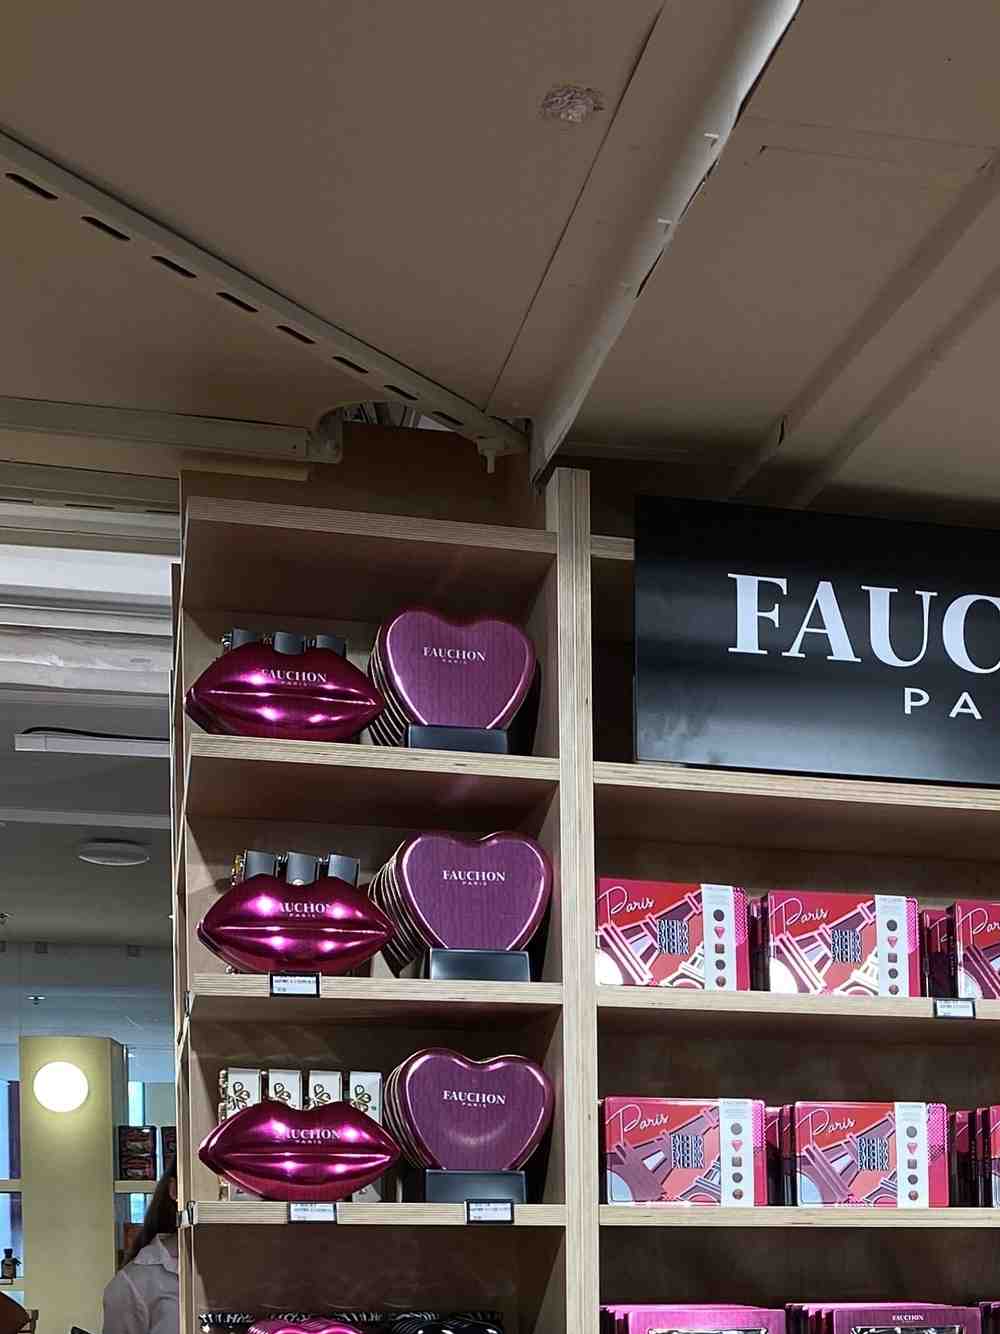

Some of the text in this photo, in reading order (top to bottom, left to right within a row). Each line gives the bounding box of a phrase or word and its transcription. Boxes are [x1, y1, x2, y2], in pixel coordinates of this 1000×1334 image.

[423, 646, 486, 661] FAUCHON
[261, 668, 327, 682] FAUCHON
[443, 869, 506, 882] FAUCHON
[598, 886, 655, 924] Paris
[771, 897, 831, 935] Paris
[443, 1090, 506, 1105] FAUCHON
[605, 1104, 670, 1144] Paris
[797, 1107, 856, 1145] Paris
